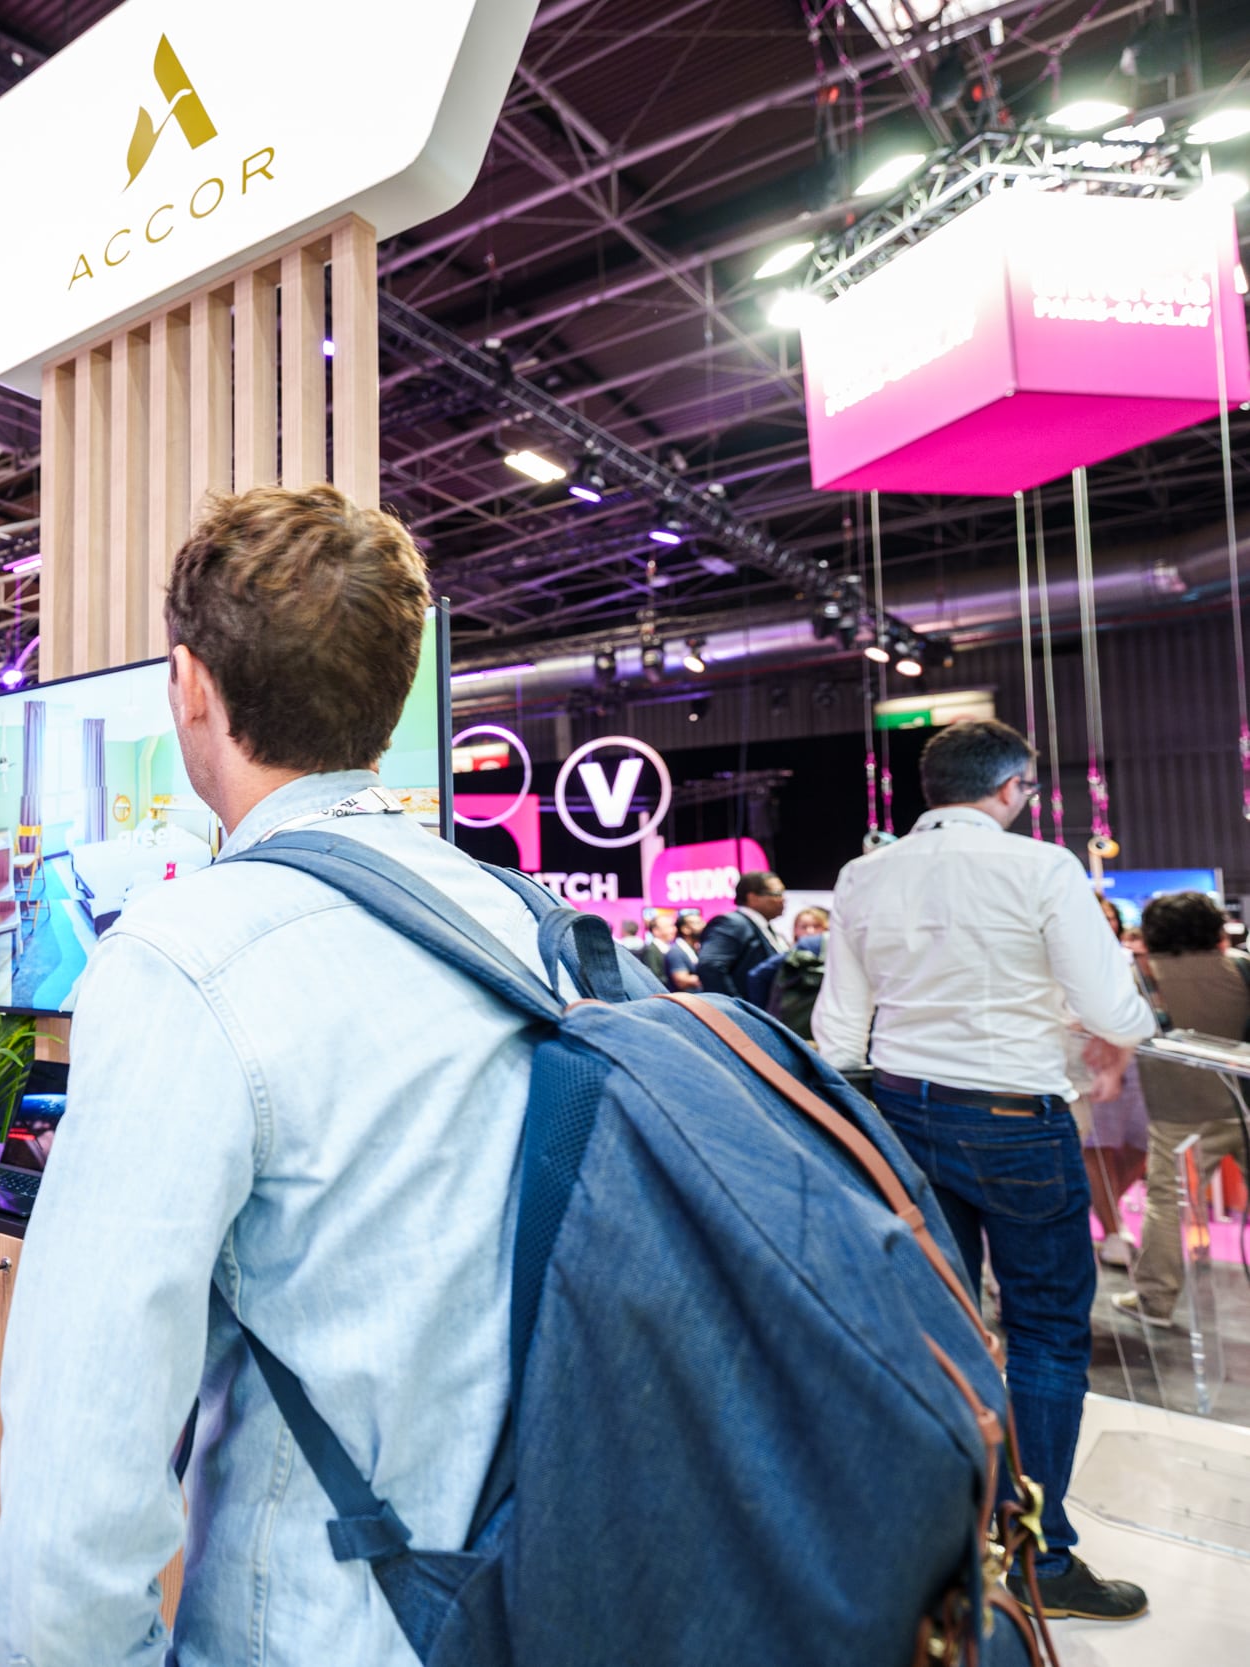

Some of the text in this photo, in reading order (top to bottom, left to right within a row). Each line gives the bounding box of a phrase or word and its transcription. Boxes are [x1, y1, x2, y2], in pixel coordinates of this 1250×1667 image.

[68, 147, 275, 290] ACCOR
[578, 758, 644, 828] V
[525, 872, 618, 903] TCH
